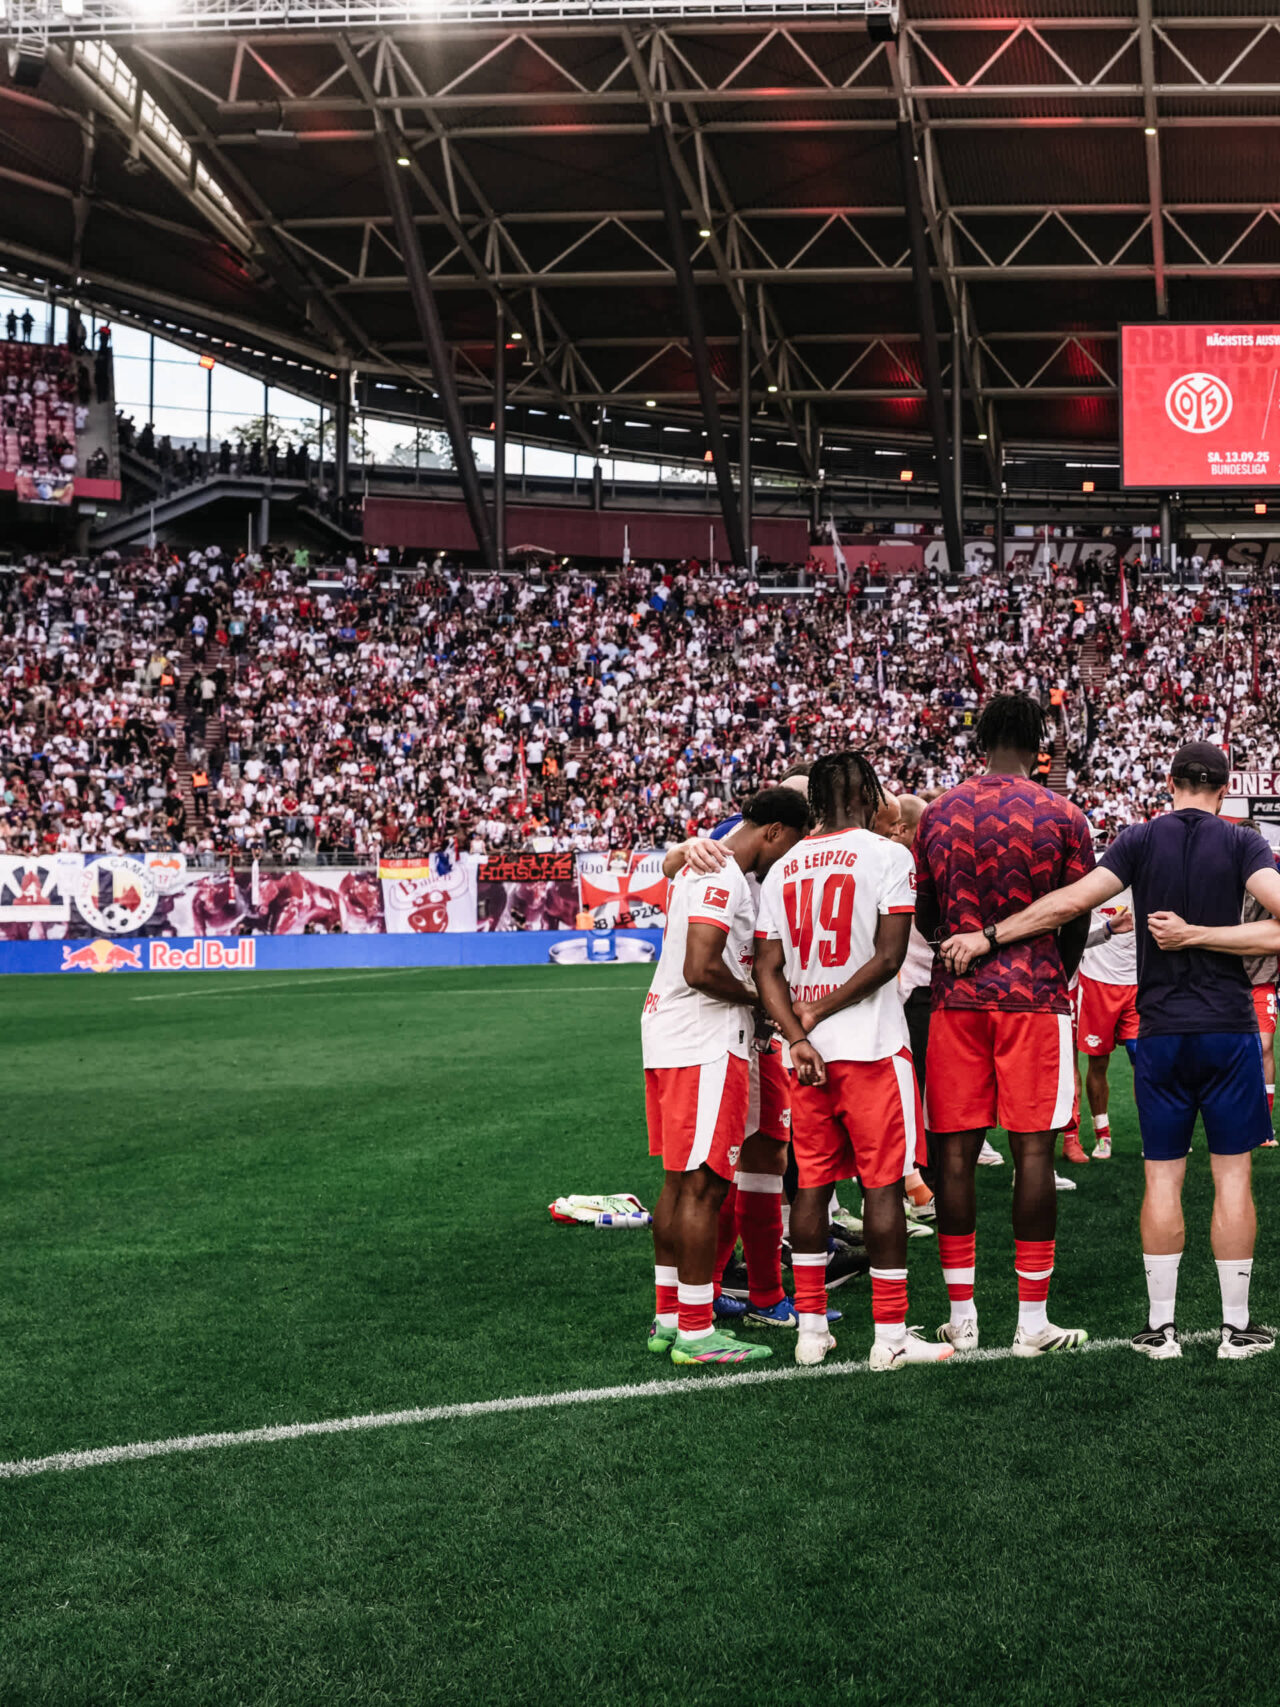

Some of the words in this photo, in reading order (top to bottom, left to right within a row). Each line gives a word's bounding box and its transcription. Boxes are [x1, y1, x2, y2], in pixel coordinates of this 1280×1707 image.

[1206, 333, 1254, 346] NÄCHSTES
[1207, 452, 1223, 462] SA.
[1225, 451, 1270, 462] 13.09.25
[1211, 464, 1267, 475] BUNDESLIGA
[784, 859, 799, 879] RB
[805, 850, 858, 869] LEIPZIG
[479, 865, 571, 880] HIRSCHE
[783, 873, 856, 970] 49
[150, 939, 202, 968] Red
[204, 938, 256, 968] Bull
